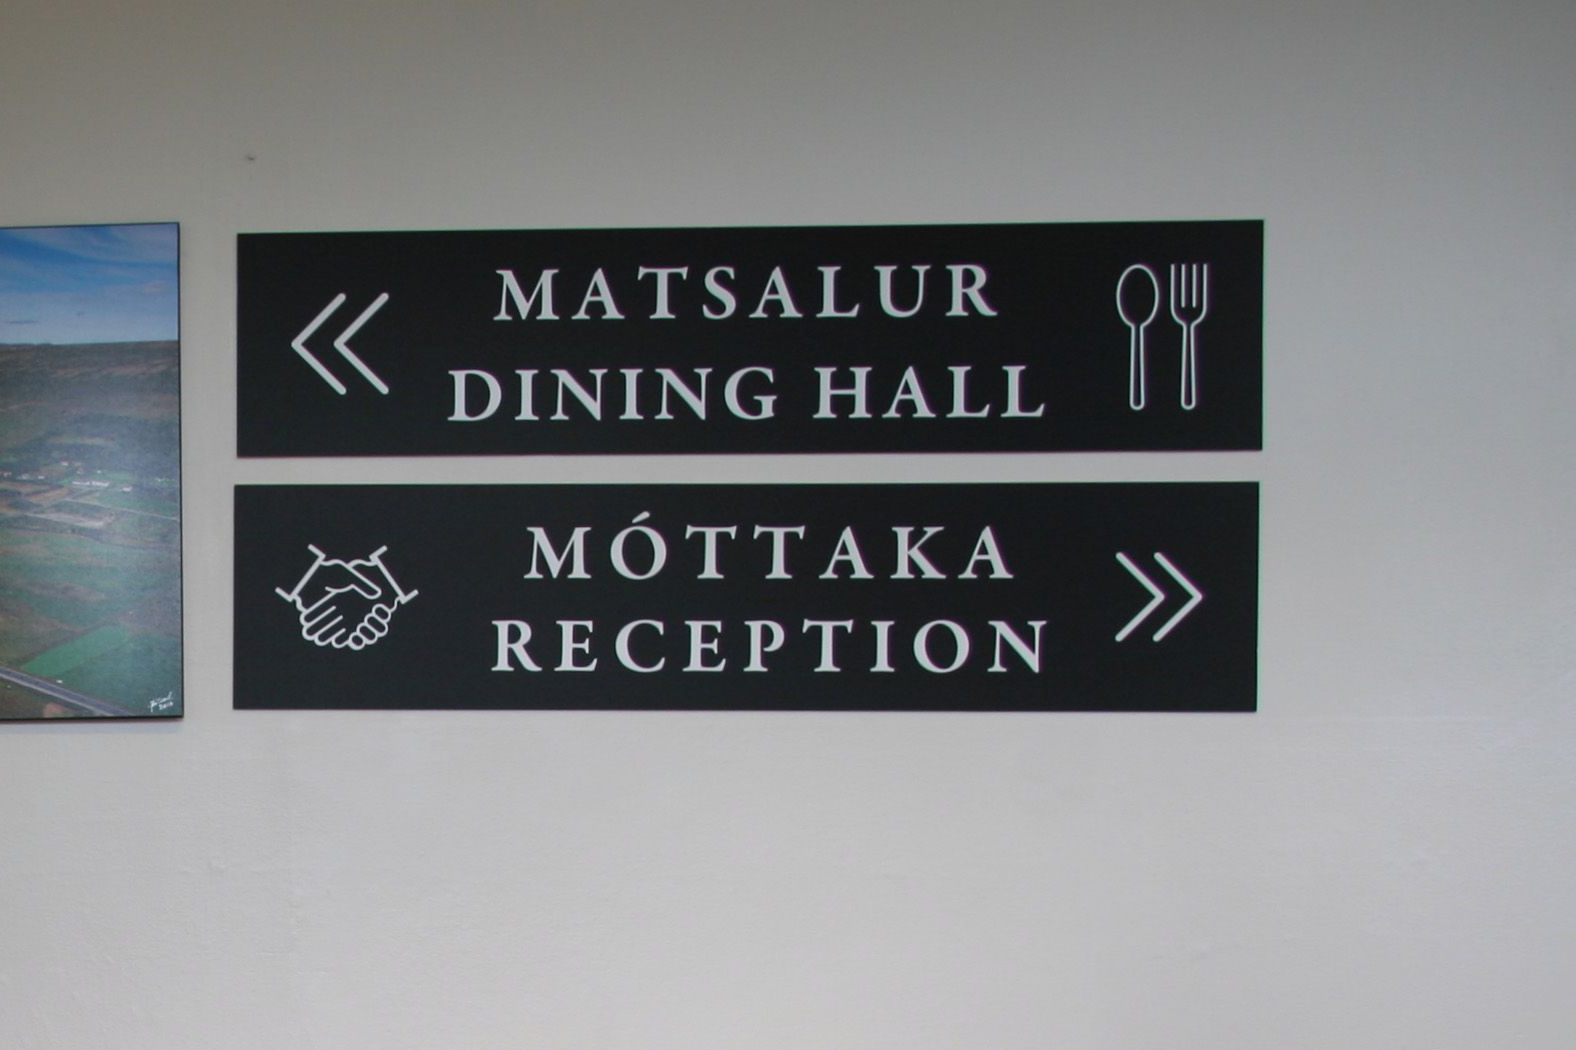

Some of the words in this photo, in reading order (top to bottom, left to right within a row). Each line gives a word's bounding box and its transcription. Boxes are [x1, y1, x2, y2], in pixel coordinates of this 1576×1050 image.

[493, 265, 997, 321] MATSALUR
[447, 367, 777, 422] DINING
[813, 366, 1045, 419] HALL
[523, 511, 1014, 580] MÓTTAKA
[491, 619, 1047, 674] RECEPTION
